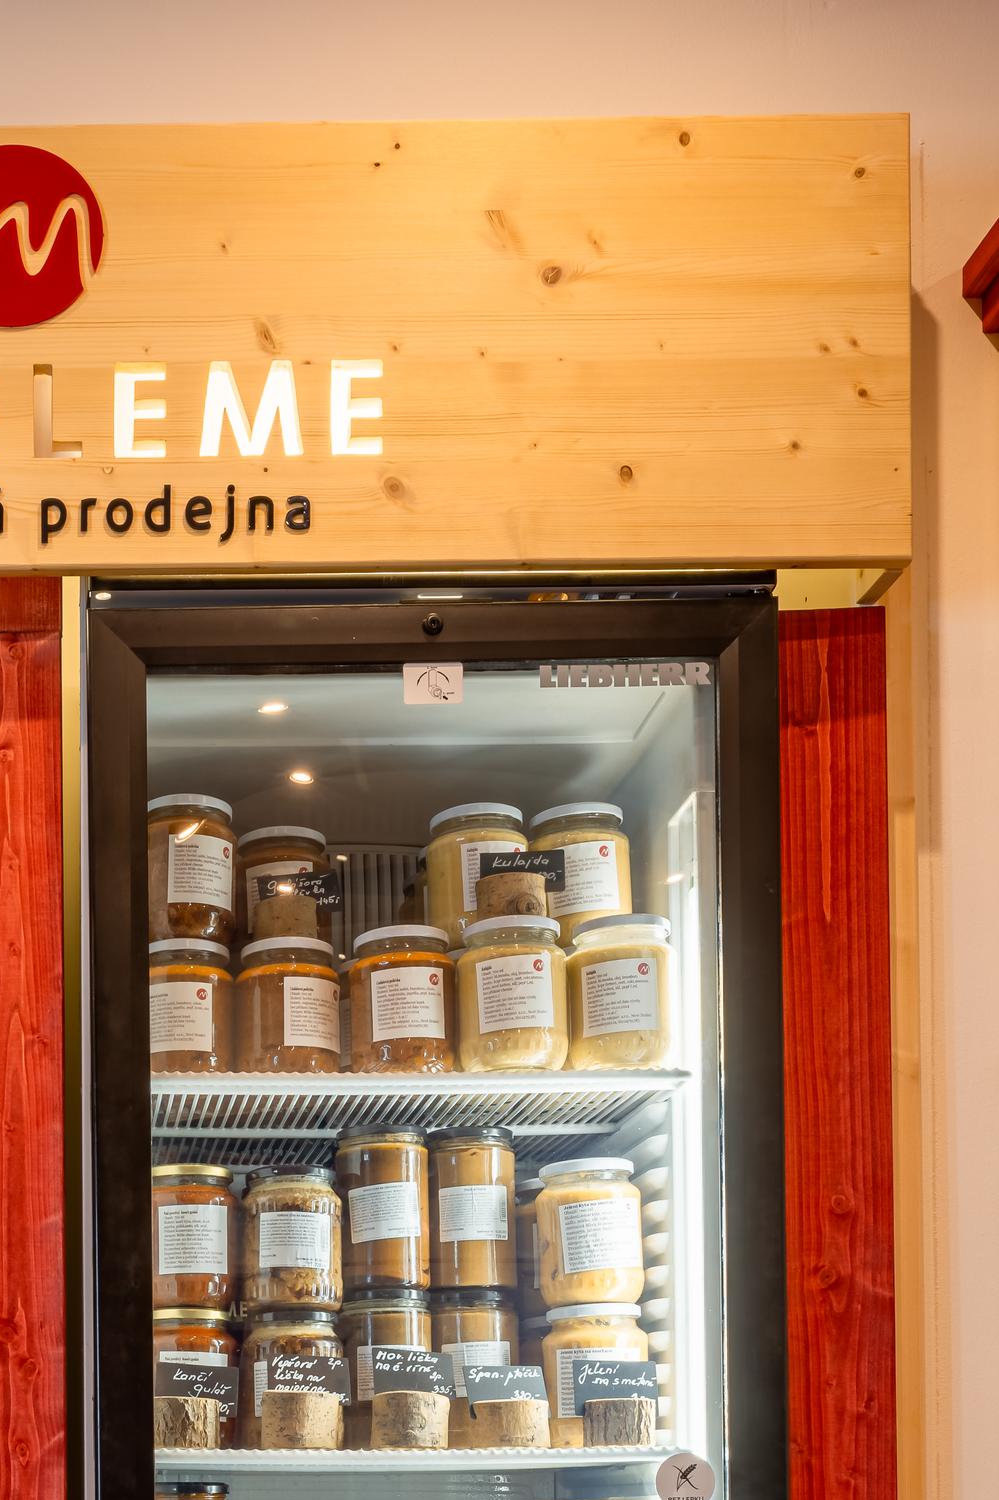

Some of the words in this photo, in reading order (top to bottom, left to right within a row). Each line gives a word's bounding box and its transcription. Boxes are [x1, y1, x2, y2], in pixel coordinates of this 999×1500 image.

[39, 484, 314, 544] prodejna
[539, 662, 711, 688] LIEBHERR
[375, 1350, 404, 1361] Hov.
[173, 1368, 213, 1382] Kančí
[578, 1361, 620, 1385] Jelení
[188, 1384, 232, 1398] guláš
